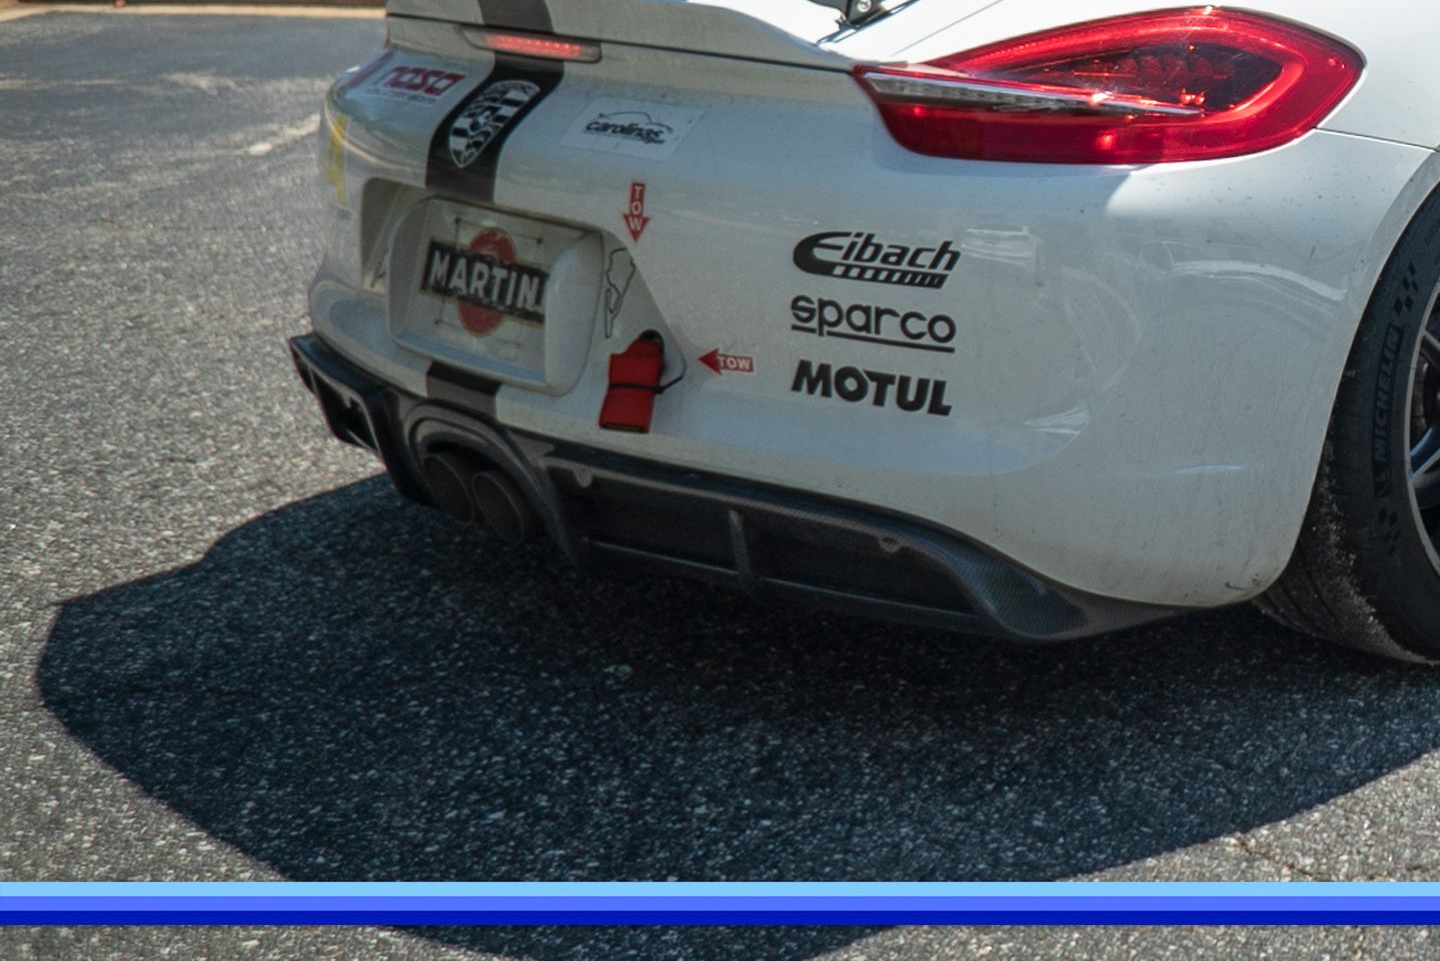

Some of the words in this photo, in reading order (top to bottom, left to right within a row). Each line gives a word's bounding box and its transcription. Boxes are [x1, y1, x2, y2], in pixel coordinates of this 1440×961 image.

[632, 186, 645, 231] TOW
[792, 231, 961, 288] Eibach
[790, 295, 956, 343] sparco
[718, 356, 751, 369] TOW
[791, 359, 952, 415] MOTUL
[1376, 326, 1404, 462] MICHELIN
